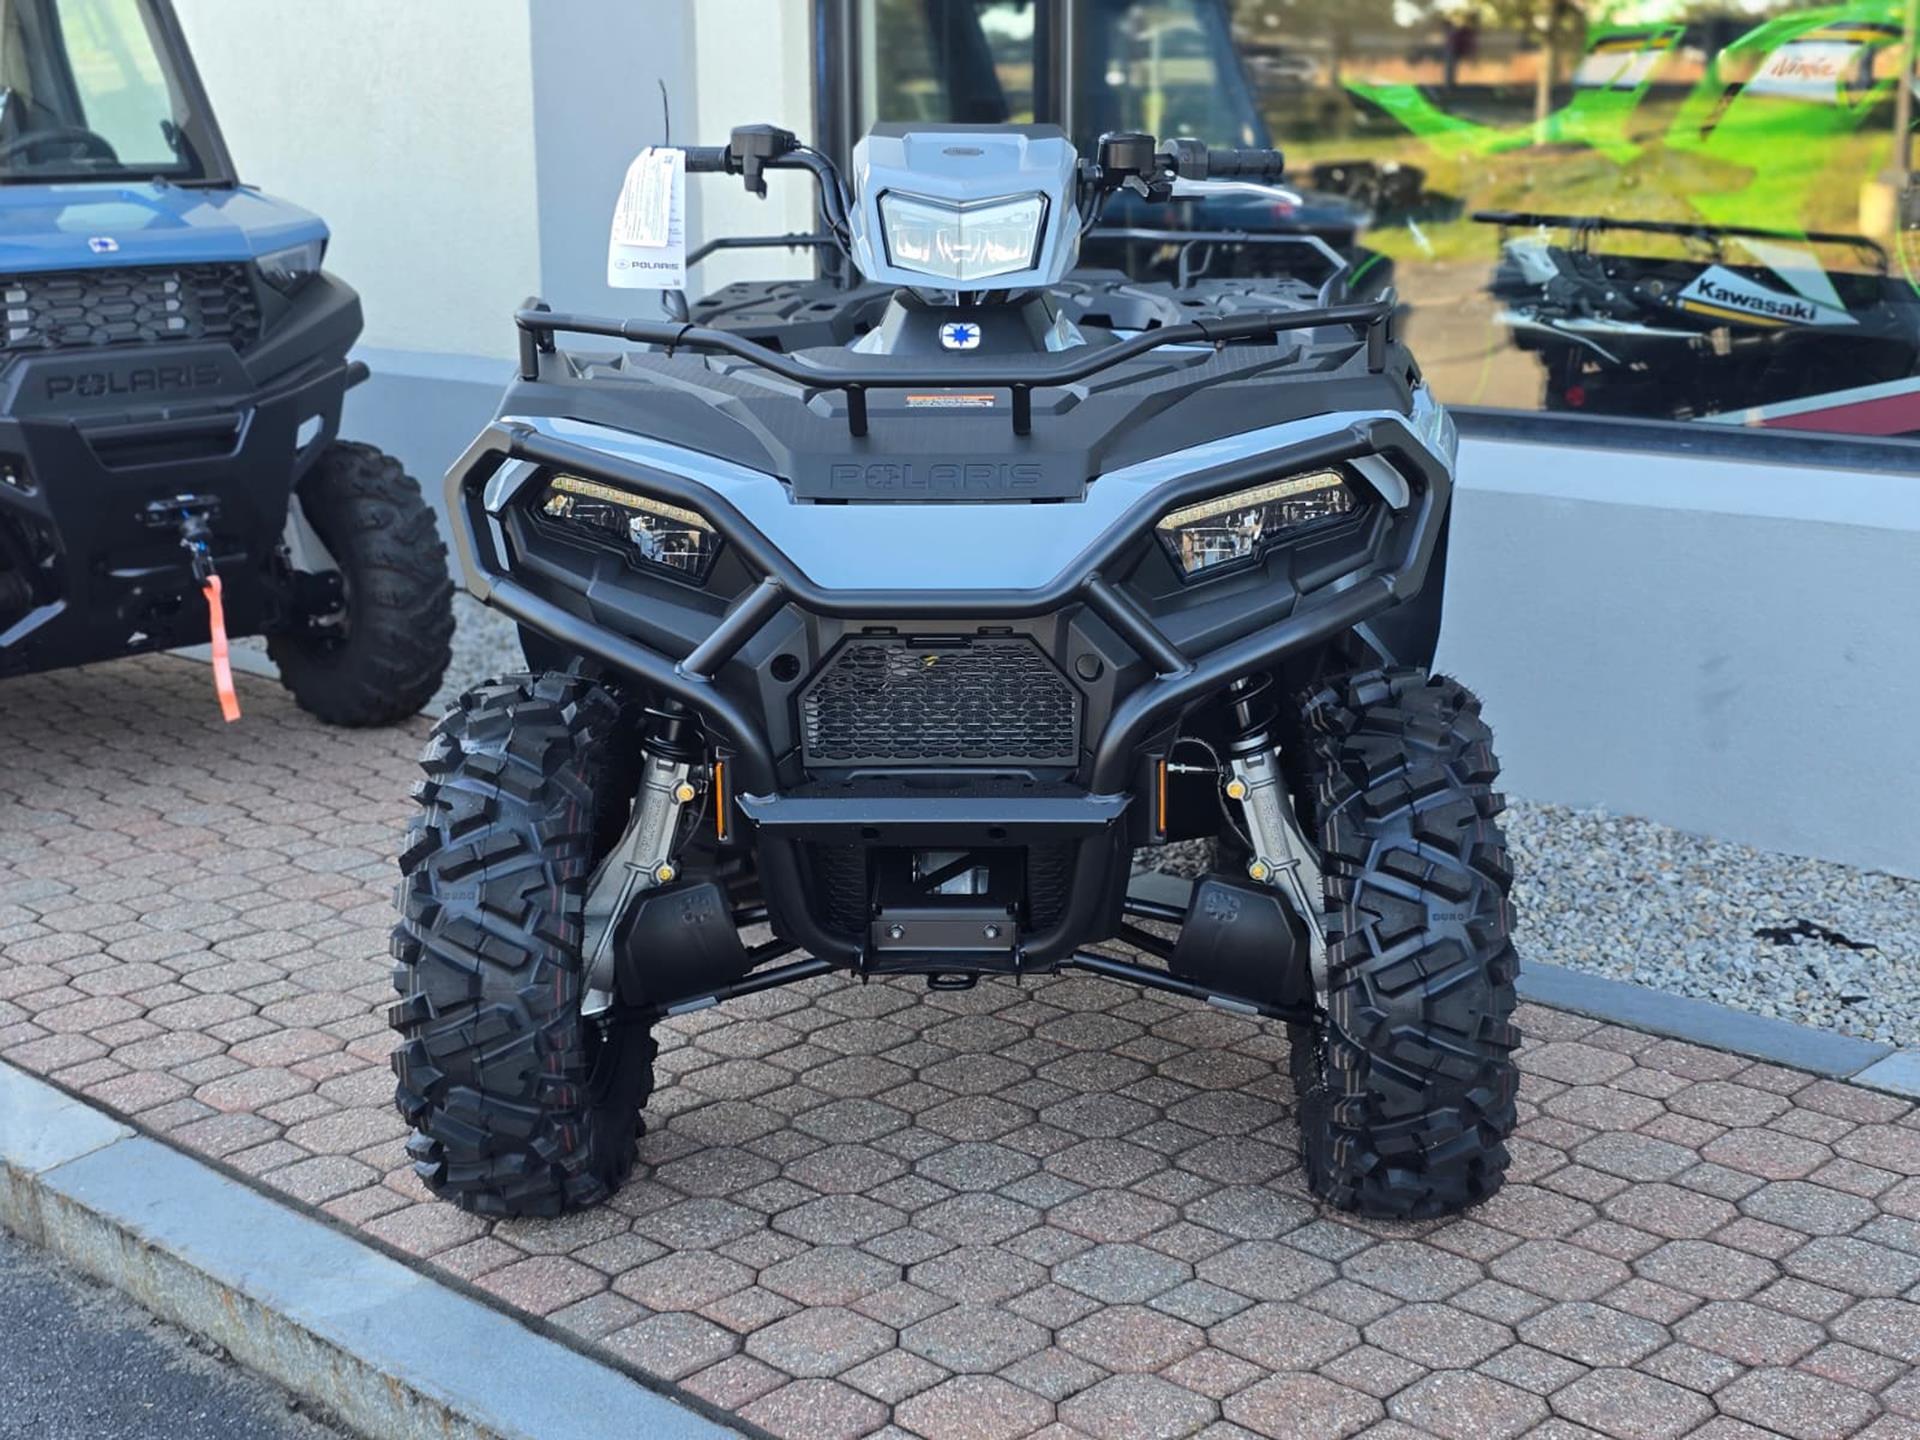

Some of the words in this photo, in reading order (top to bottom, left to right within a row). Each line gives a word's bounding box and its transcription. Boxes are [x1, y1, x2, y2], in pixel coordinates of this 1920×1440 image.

[632, 261, 679, 270] POLARIS
[1697, 278, 1818, 321] Kawasaki
[46, 362, 222, 400] POLARIS
[830, 463, 1043, 490] POLARIS
